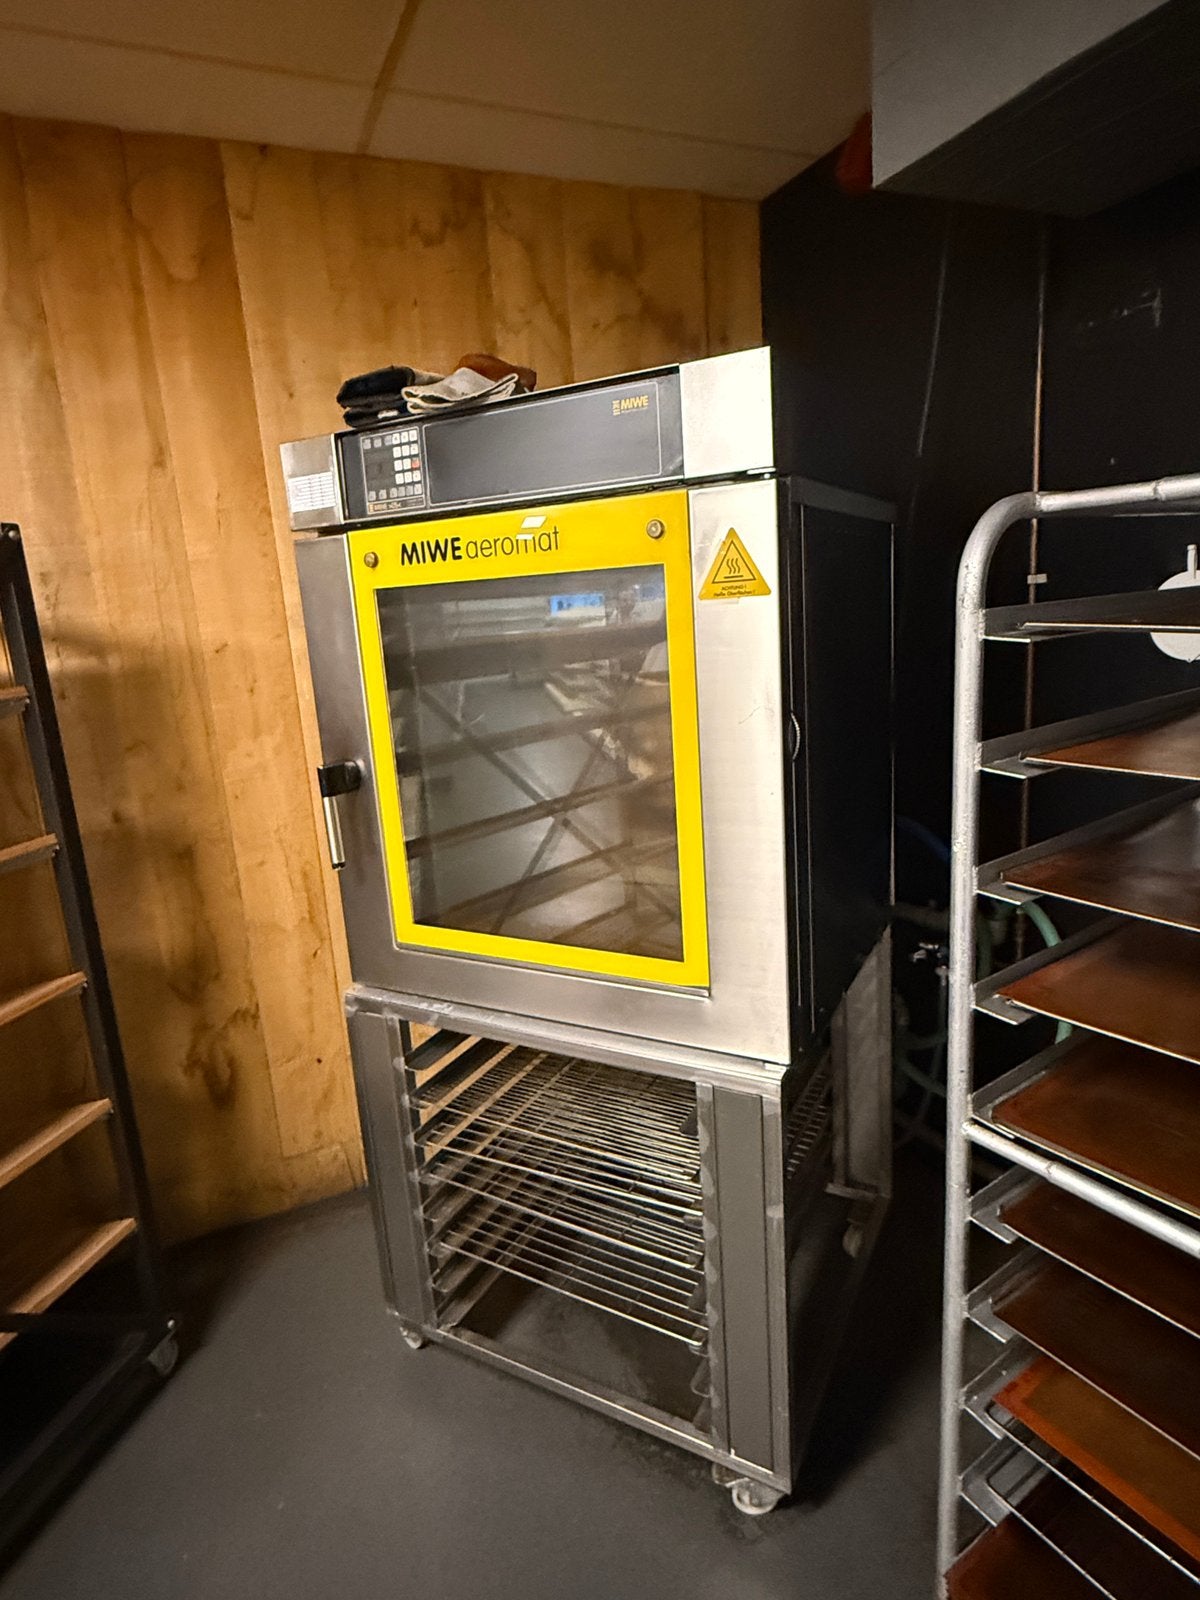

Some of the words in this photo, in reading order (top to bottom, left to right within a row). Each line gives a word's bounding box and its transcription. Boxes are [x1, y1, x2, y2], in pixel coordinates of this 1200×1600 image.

[620, 395, 649, 410] MIWE
[401, 537, 462, 566] MIWE
[466, 526, 559, 559] aeromat
